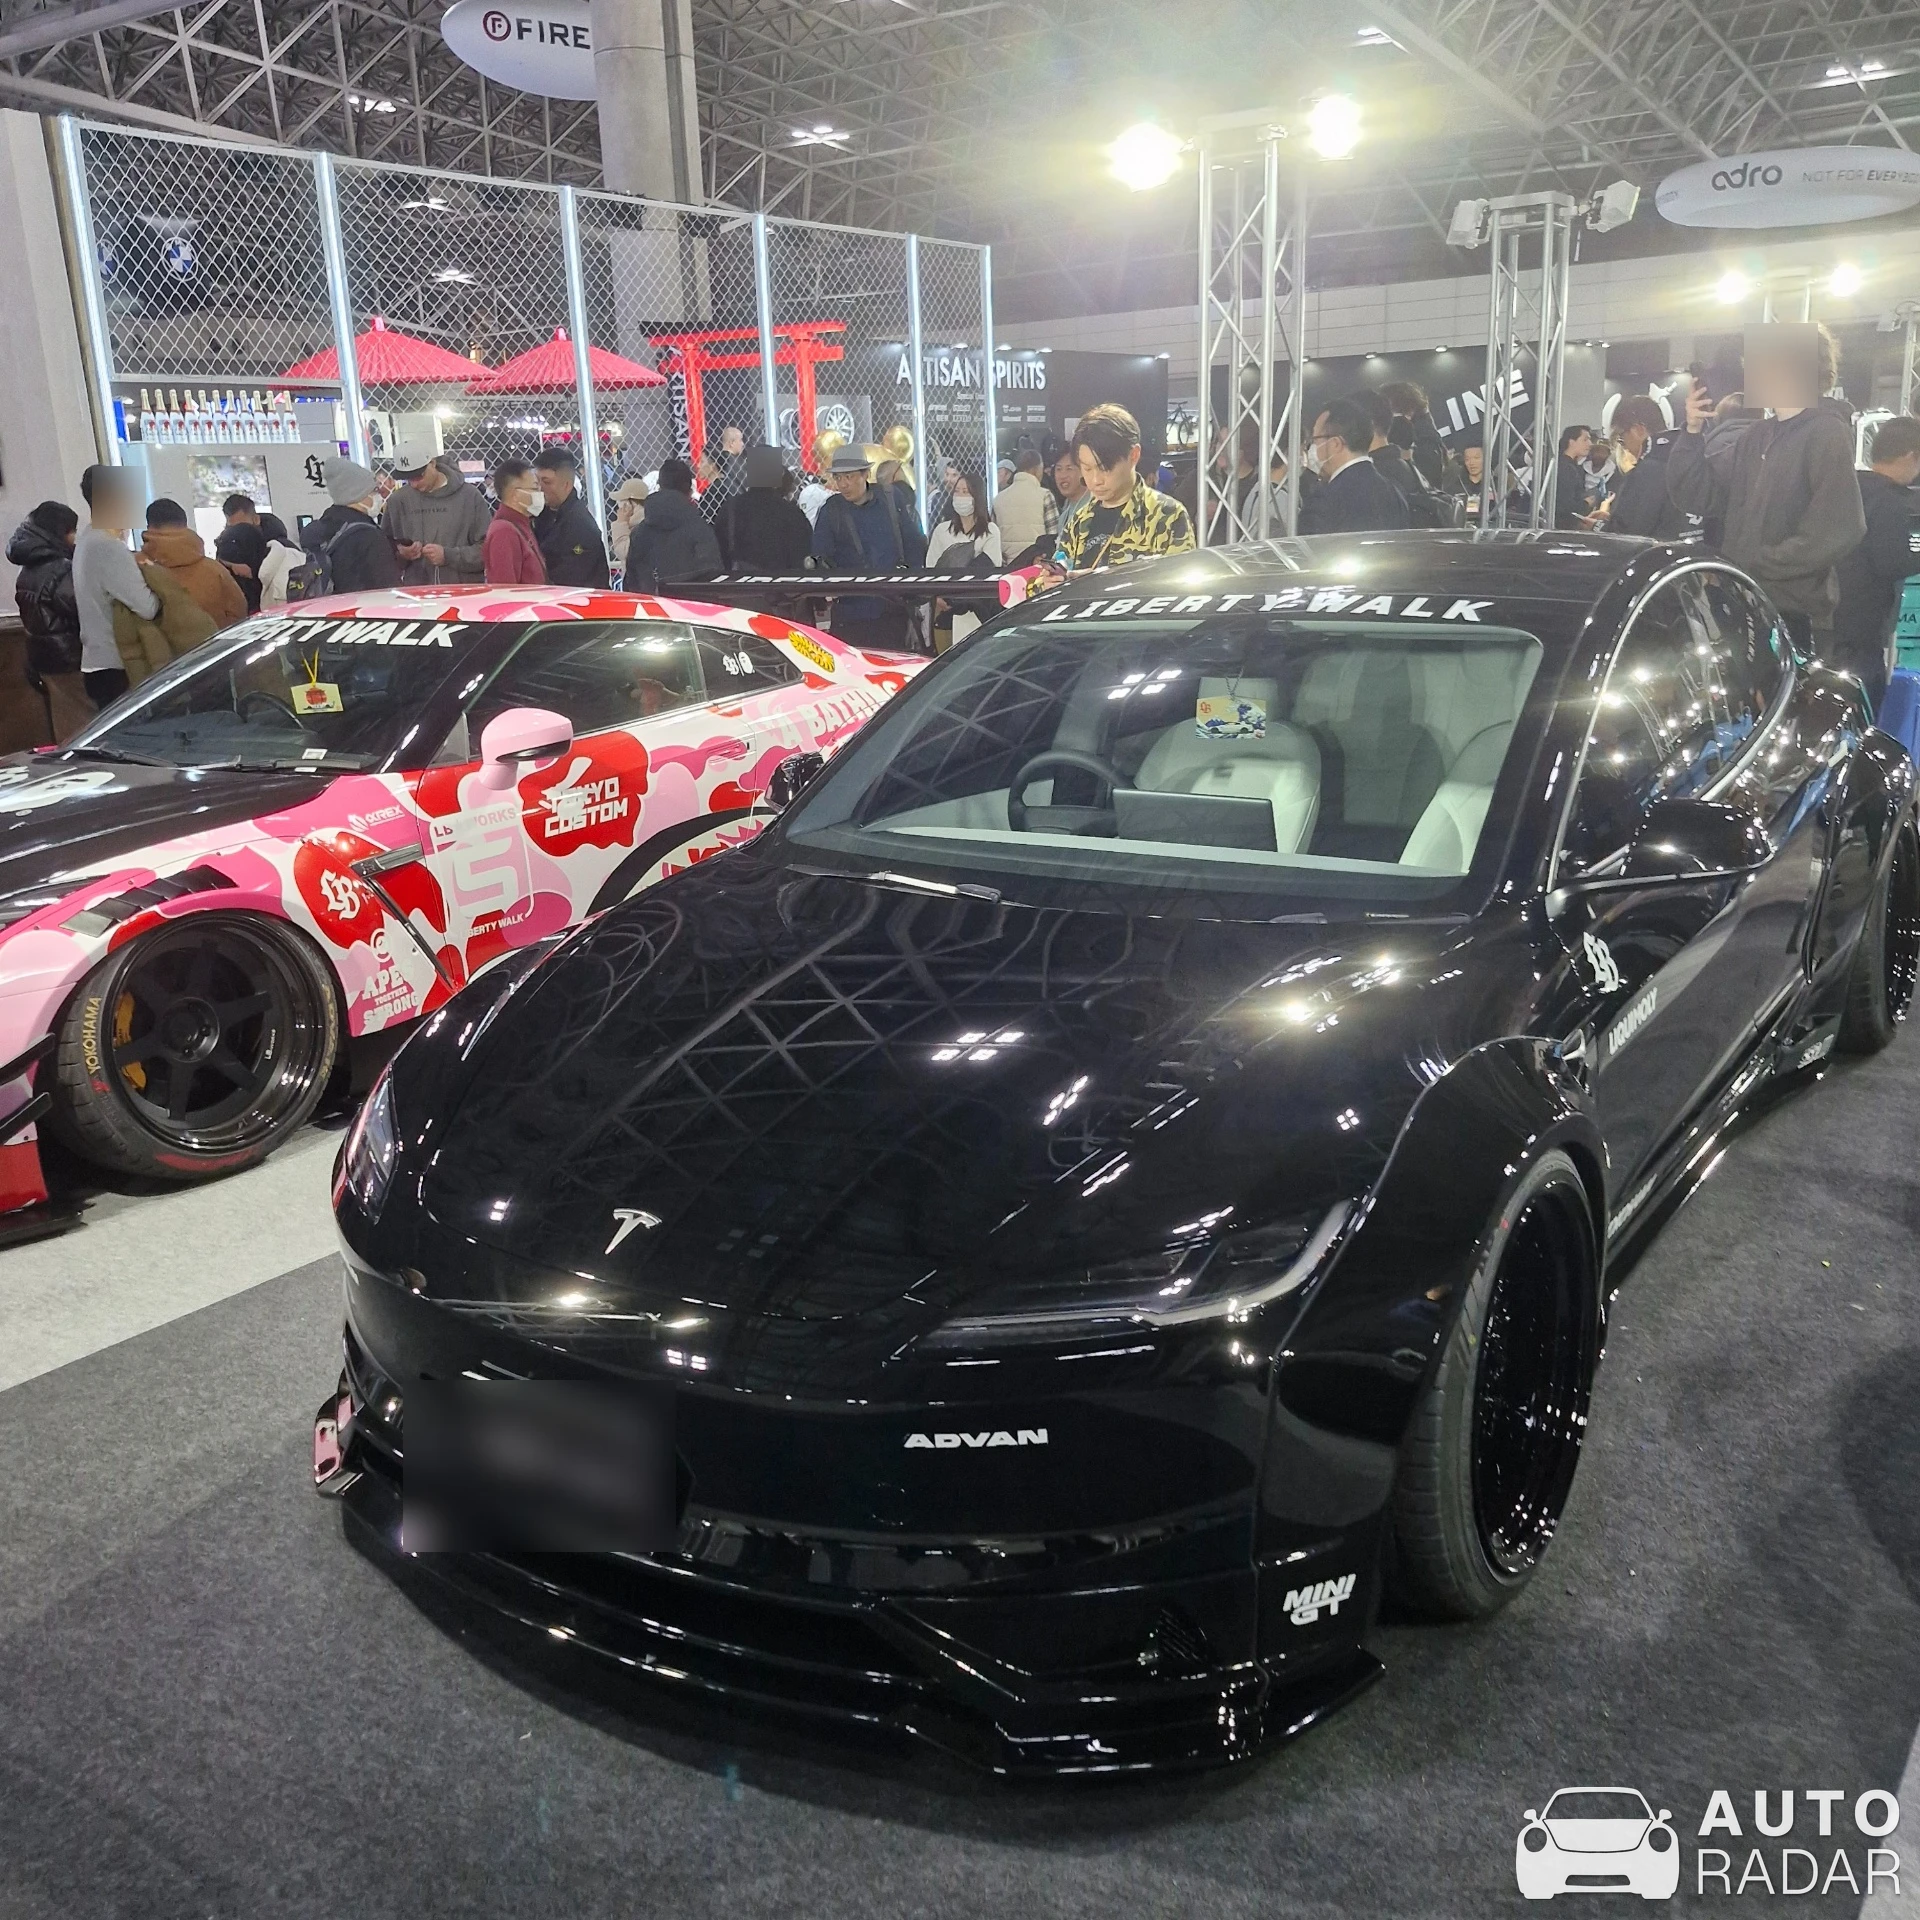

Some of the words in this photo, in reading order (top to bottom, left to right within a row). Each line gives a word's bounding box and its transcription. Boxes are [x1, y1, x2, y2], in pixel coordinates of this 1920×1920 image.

[1711, 162, 1783, 191] adro
[1802, 169, 1834, 183] NOT
[1837, 169, 1864, 182] FOR
[1866, 169, 1920, 184] EVERYBO
[896, 353, 981, 389] ATISAN
[1041, 593, 1285, 621] LIBERTY
[1305, 592, 1495, 622] WALK
[215, 619, 335, 643] BERTY
[326, 620, 470, 648] WALK
[546, 777, 619, 814] TKYO
[468, 807, 517, 829] ORKS
[462, 921, 499, 939] BERTY
[498, 912, 524, 928] WALK
[82, 996, 102, 1076] YOKOHAMA
[903, 1428, 1049, 1449] ADVAN
[1282, 1573, 1357, 1612] MINI
[1290, 1592, 1351, 1626] GT
